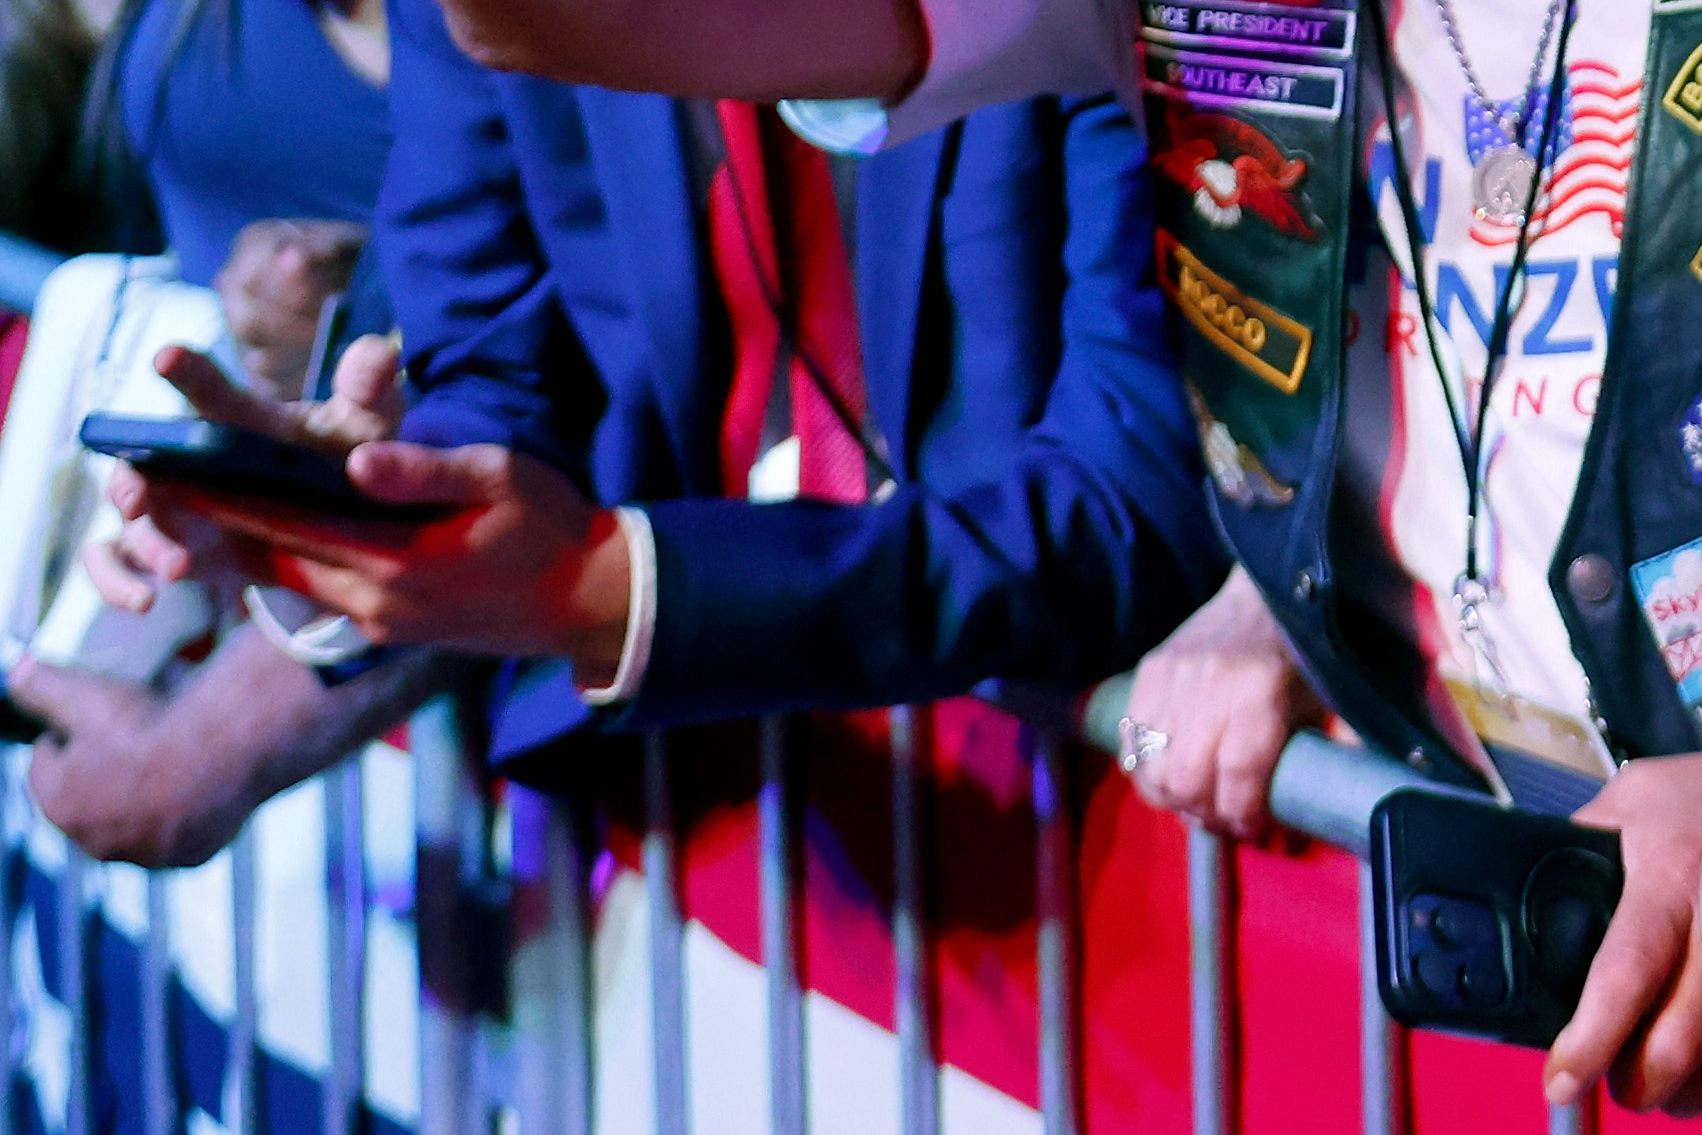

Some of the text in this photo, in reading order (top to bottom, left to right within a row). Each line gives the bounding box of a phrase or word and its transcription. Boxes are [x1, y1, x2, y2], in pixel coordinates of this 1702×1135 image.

[1147, 4, 1329, 43] VICE PRESIDENT
[1167, 62, 1299, 100] UTHEAST
